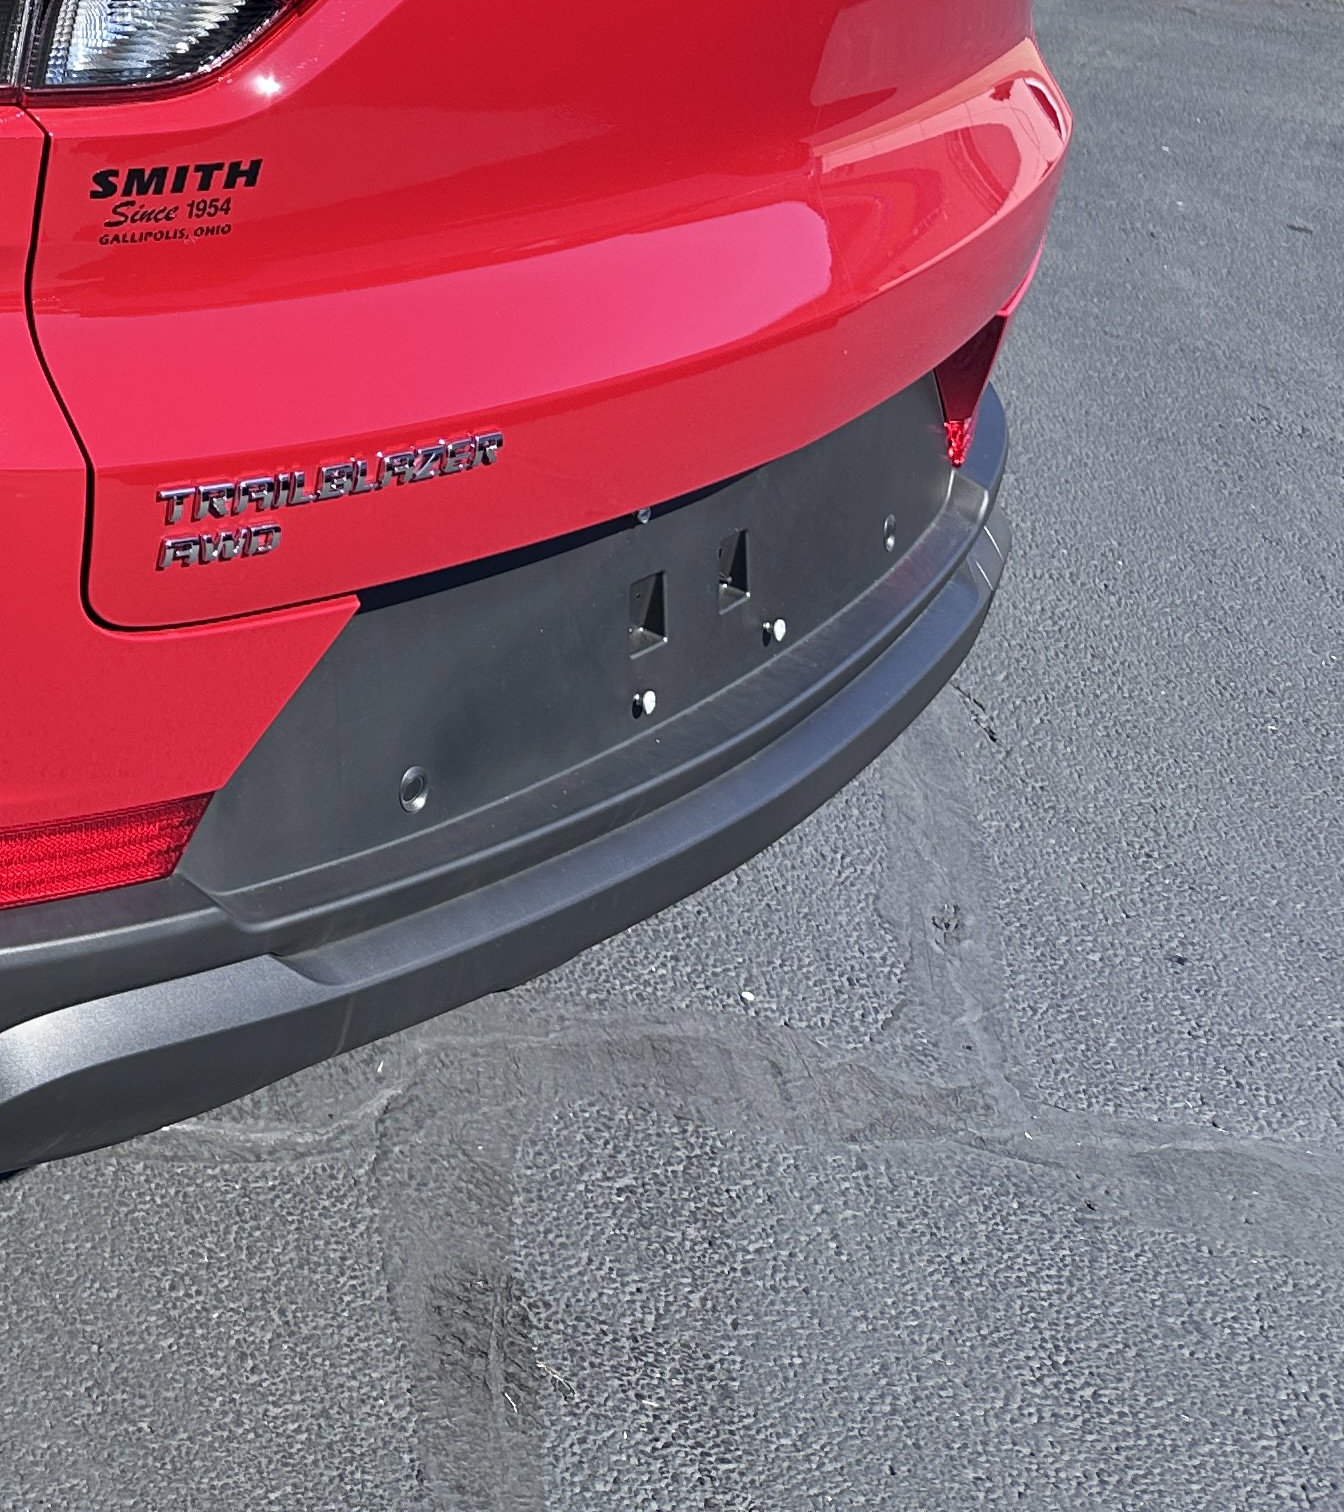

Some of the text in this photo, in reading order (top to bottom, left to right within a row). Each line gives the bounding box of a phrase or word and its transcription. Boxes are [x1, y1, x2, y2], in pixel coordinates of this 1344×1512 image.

[89, 158, 263, 199] SMITH
[103, 196, 232, 228] Since 1954
[98, 224, 232, 245] GALLIPOLIS, OHIO
[156, 430, 505, 525] TRAILBLAZER
[155, 520, 282, 572] AWD
